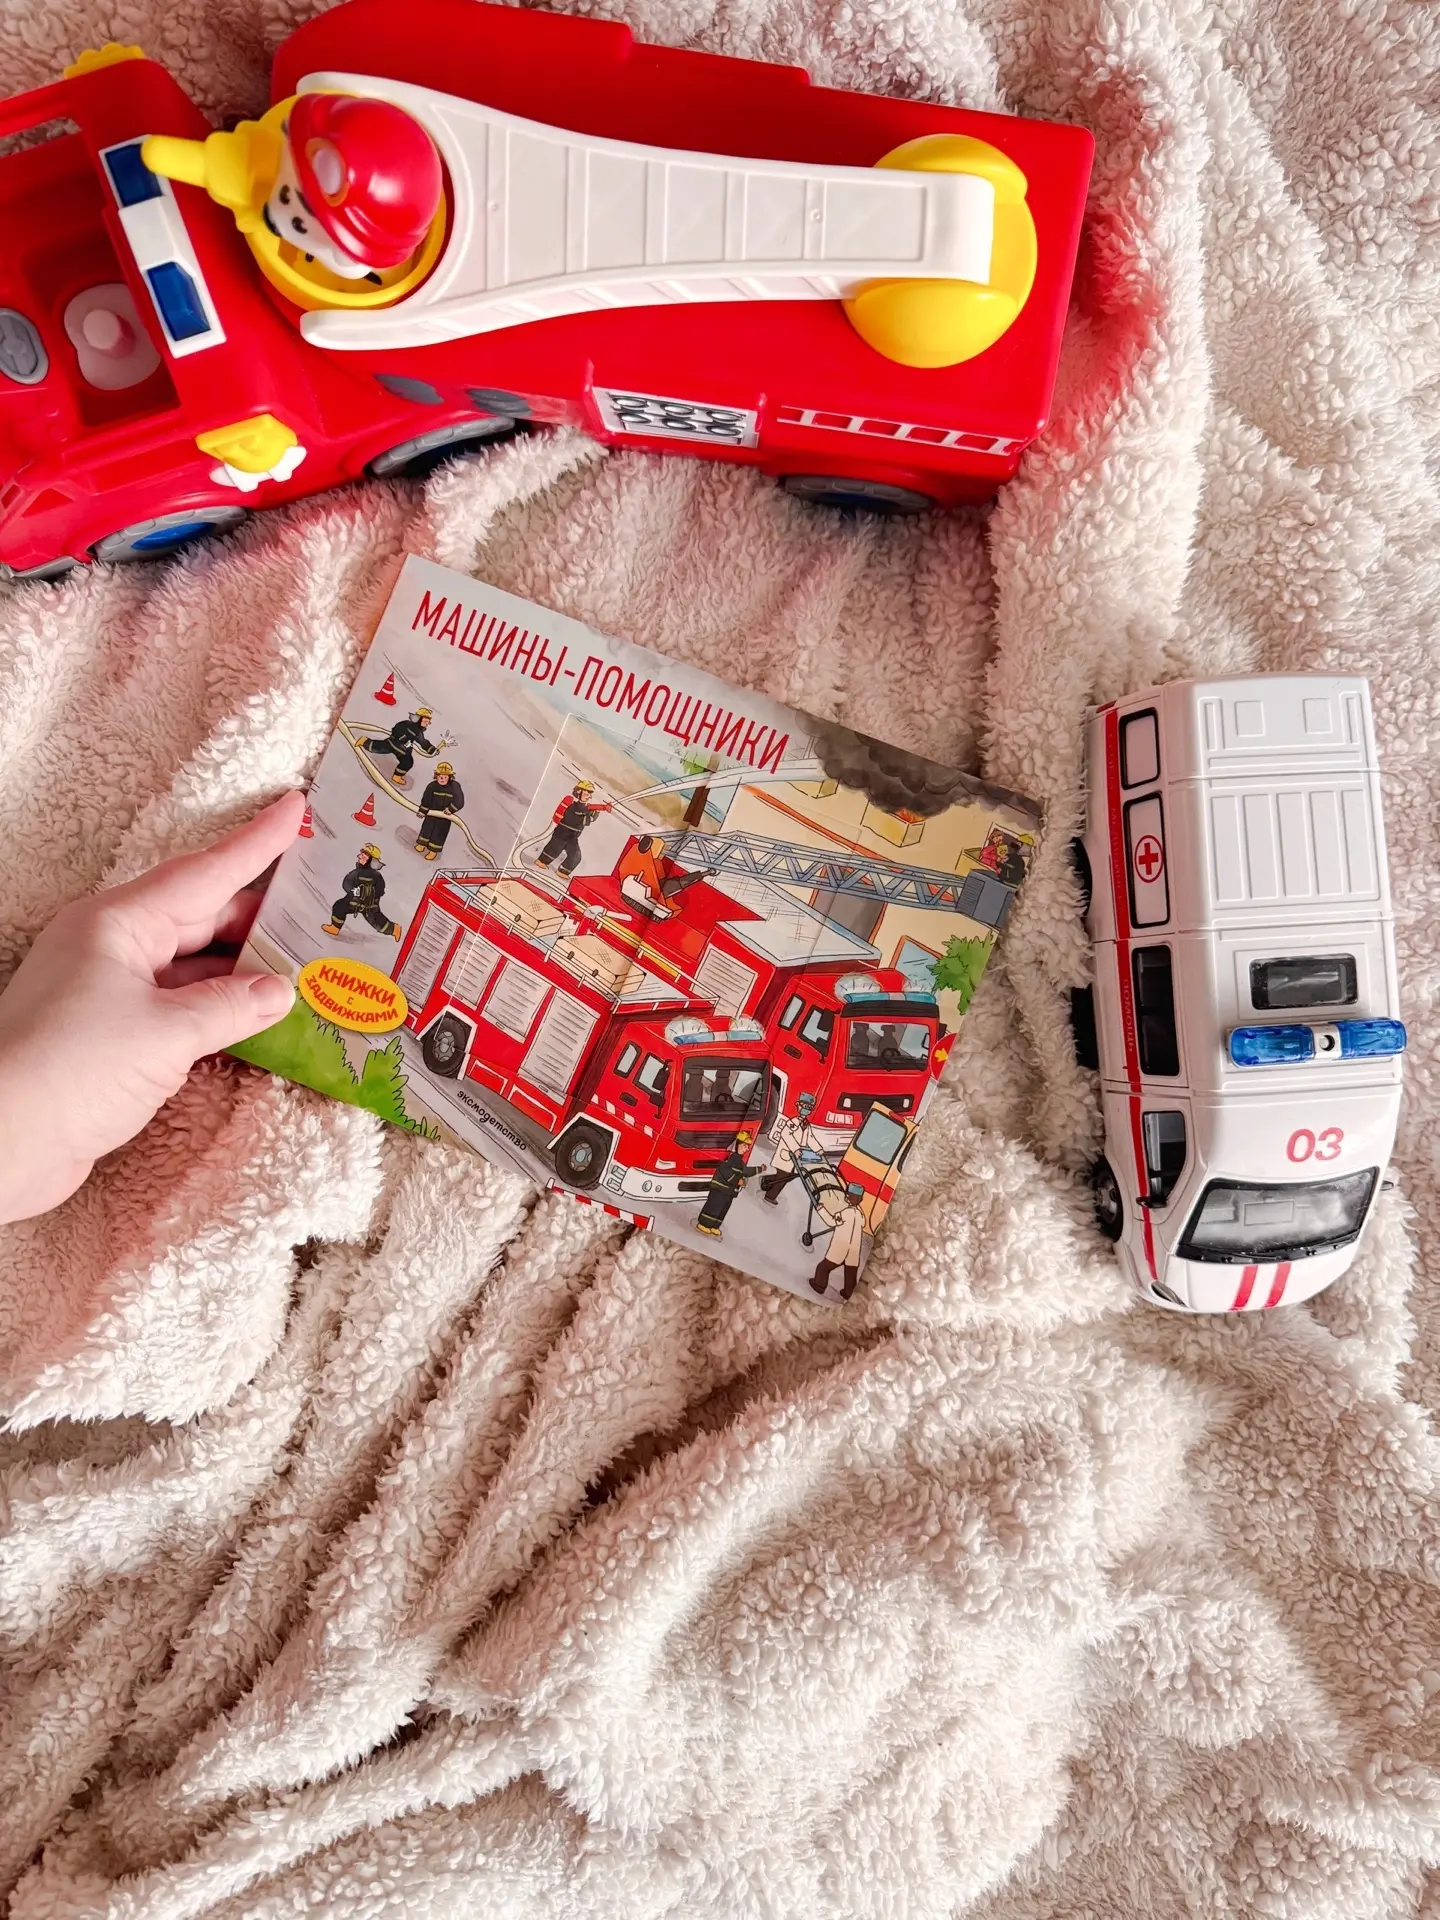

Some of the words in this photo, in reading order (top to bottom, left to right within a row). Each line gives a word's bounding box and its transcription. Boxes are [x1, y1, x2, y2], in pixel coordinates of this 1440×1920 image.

[411, 590, 790, 774] МАШИНЫ-ПОМОЩНИКИ
[304, 974, 399, 1023] ЗАДВИЖКАМИ
[318, 964, 397, 1007] КНИЖКИ
[456, 1090, 527, 1151] эксмодетство
[1286, 1126, 1345, 1163] 03
